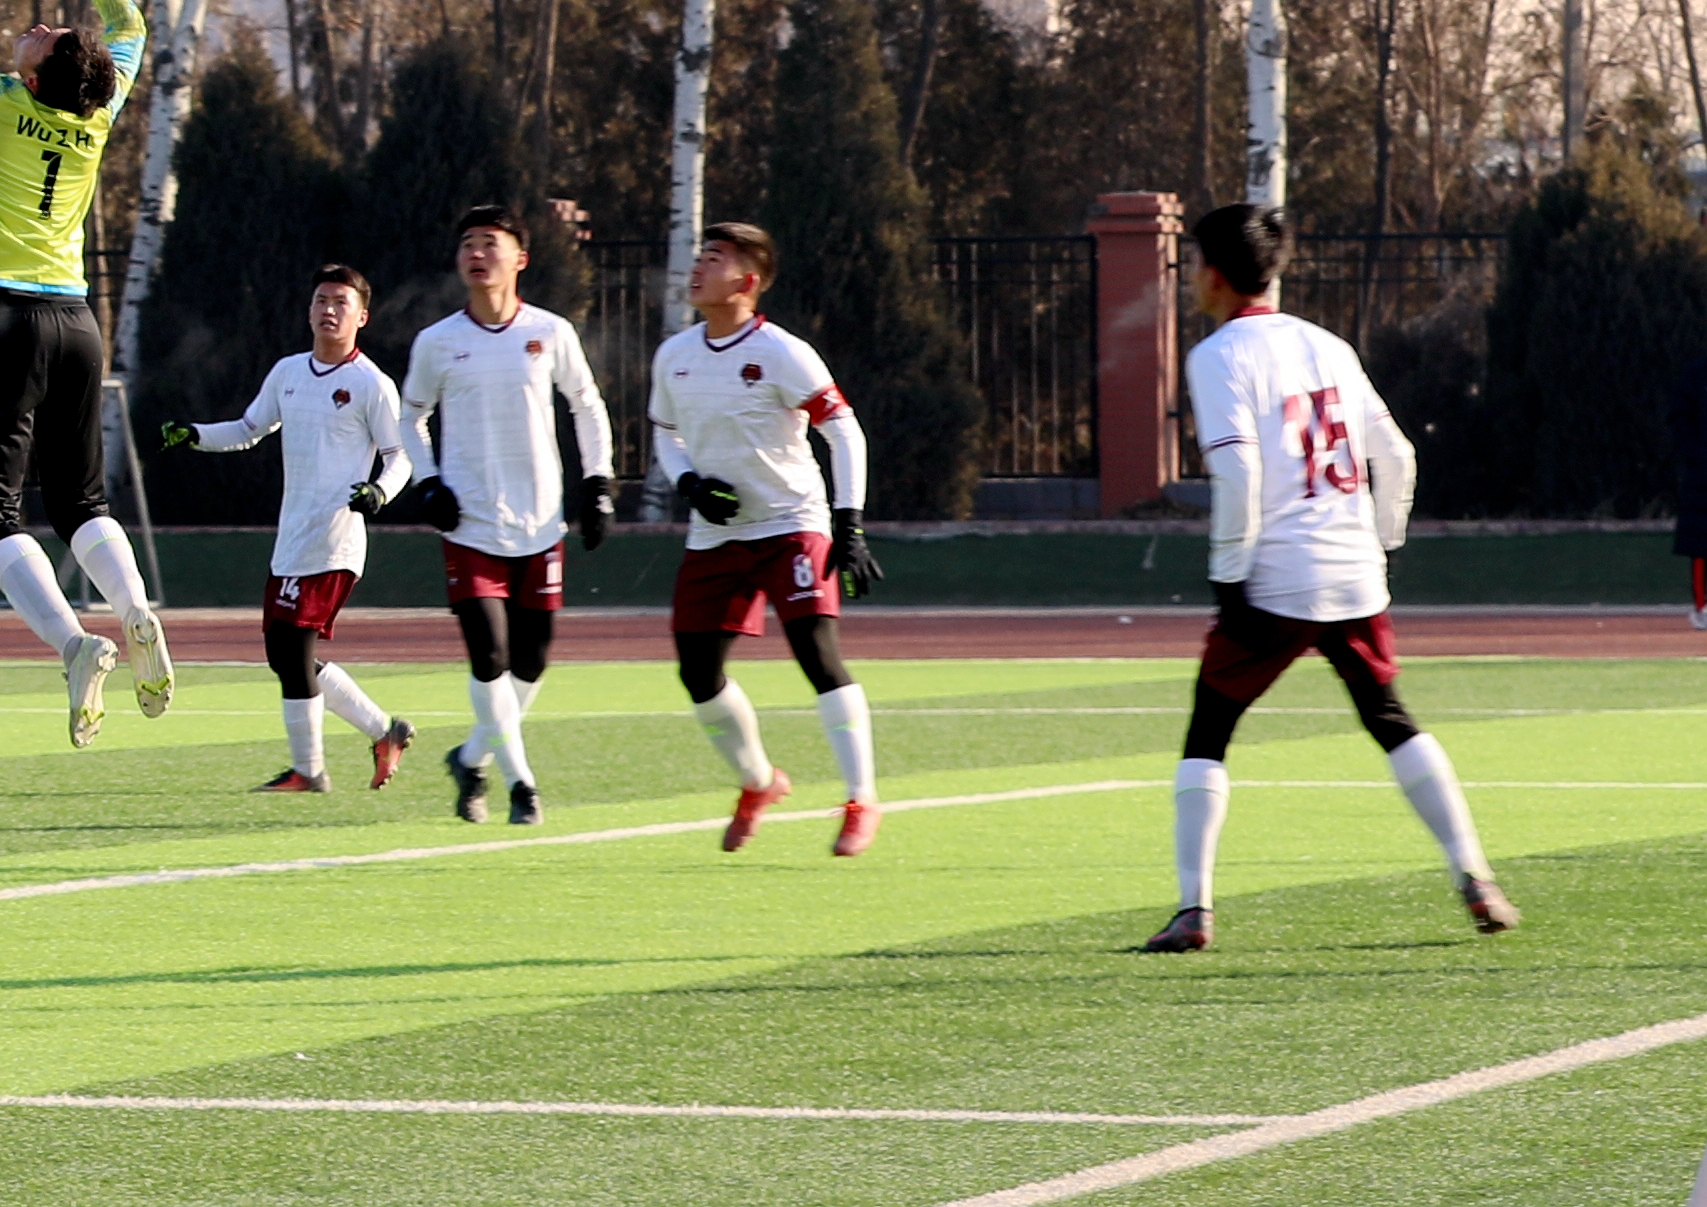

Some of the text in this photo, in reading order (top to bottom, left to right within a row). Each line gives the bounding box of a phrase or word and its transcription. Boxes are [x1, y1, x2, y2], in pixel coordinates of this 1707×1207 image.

[39, 150, 62, 220] 1
[792, 554, 815, 588] 8
[279, 577, 301, 601] 14
